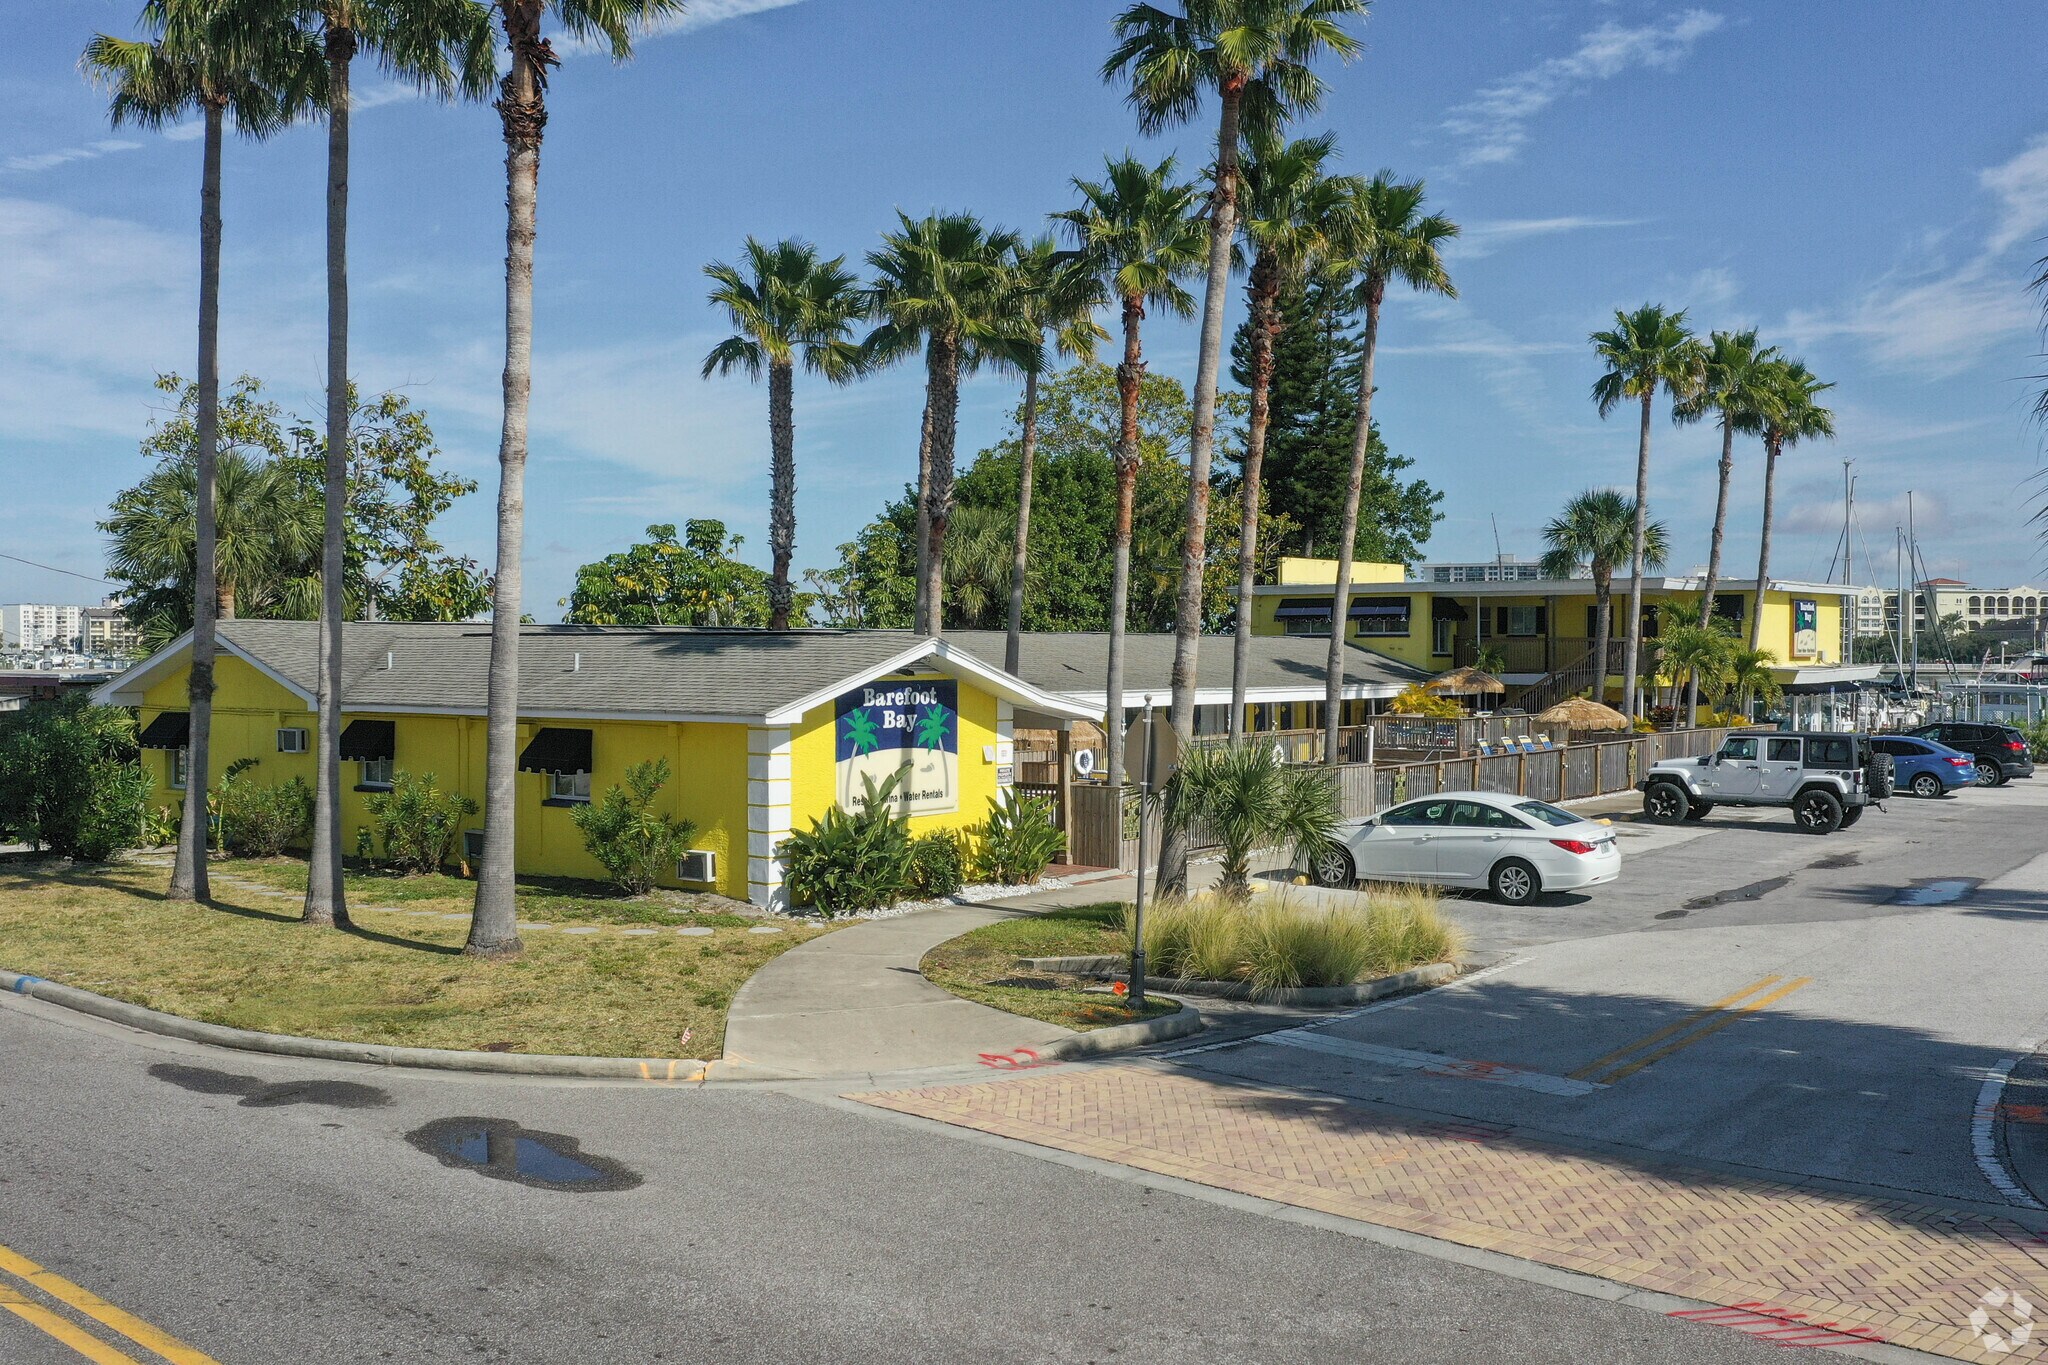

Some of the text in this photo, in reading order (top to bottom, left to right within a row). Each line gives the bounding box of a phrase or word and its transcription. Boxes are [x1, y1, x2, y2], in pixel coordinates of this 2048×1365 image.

[863, 687, 937, 706] Barefoot
[883, 710, 917, 732] Bay
[903, 791, 921, 801] Water
[921, 789, 943, 800] Rentals
